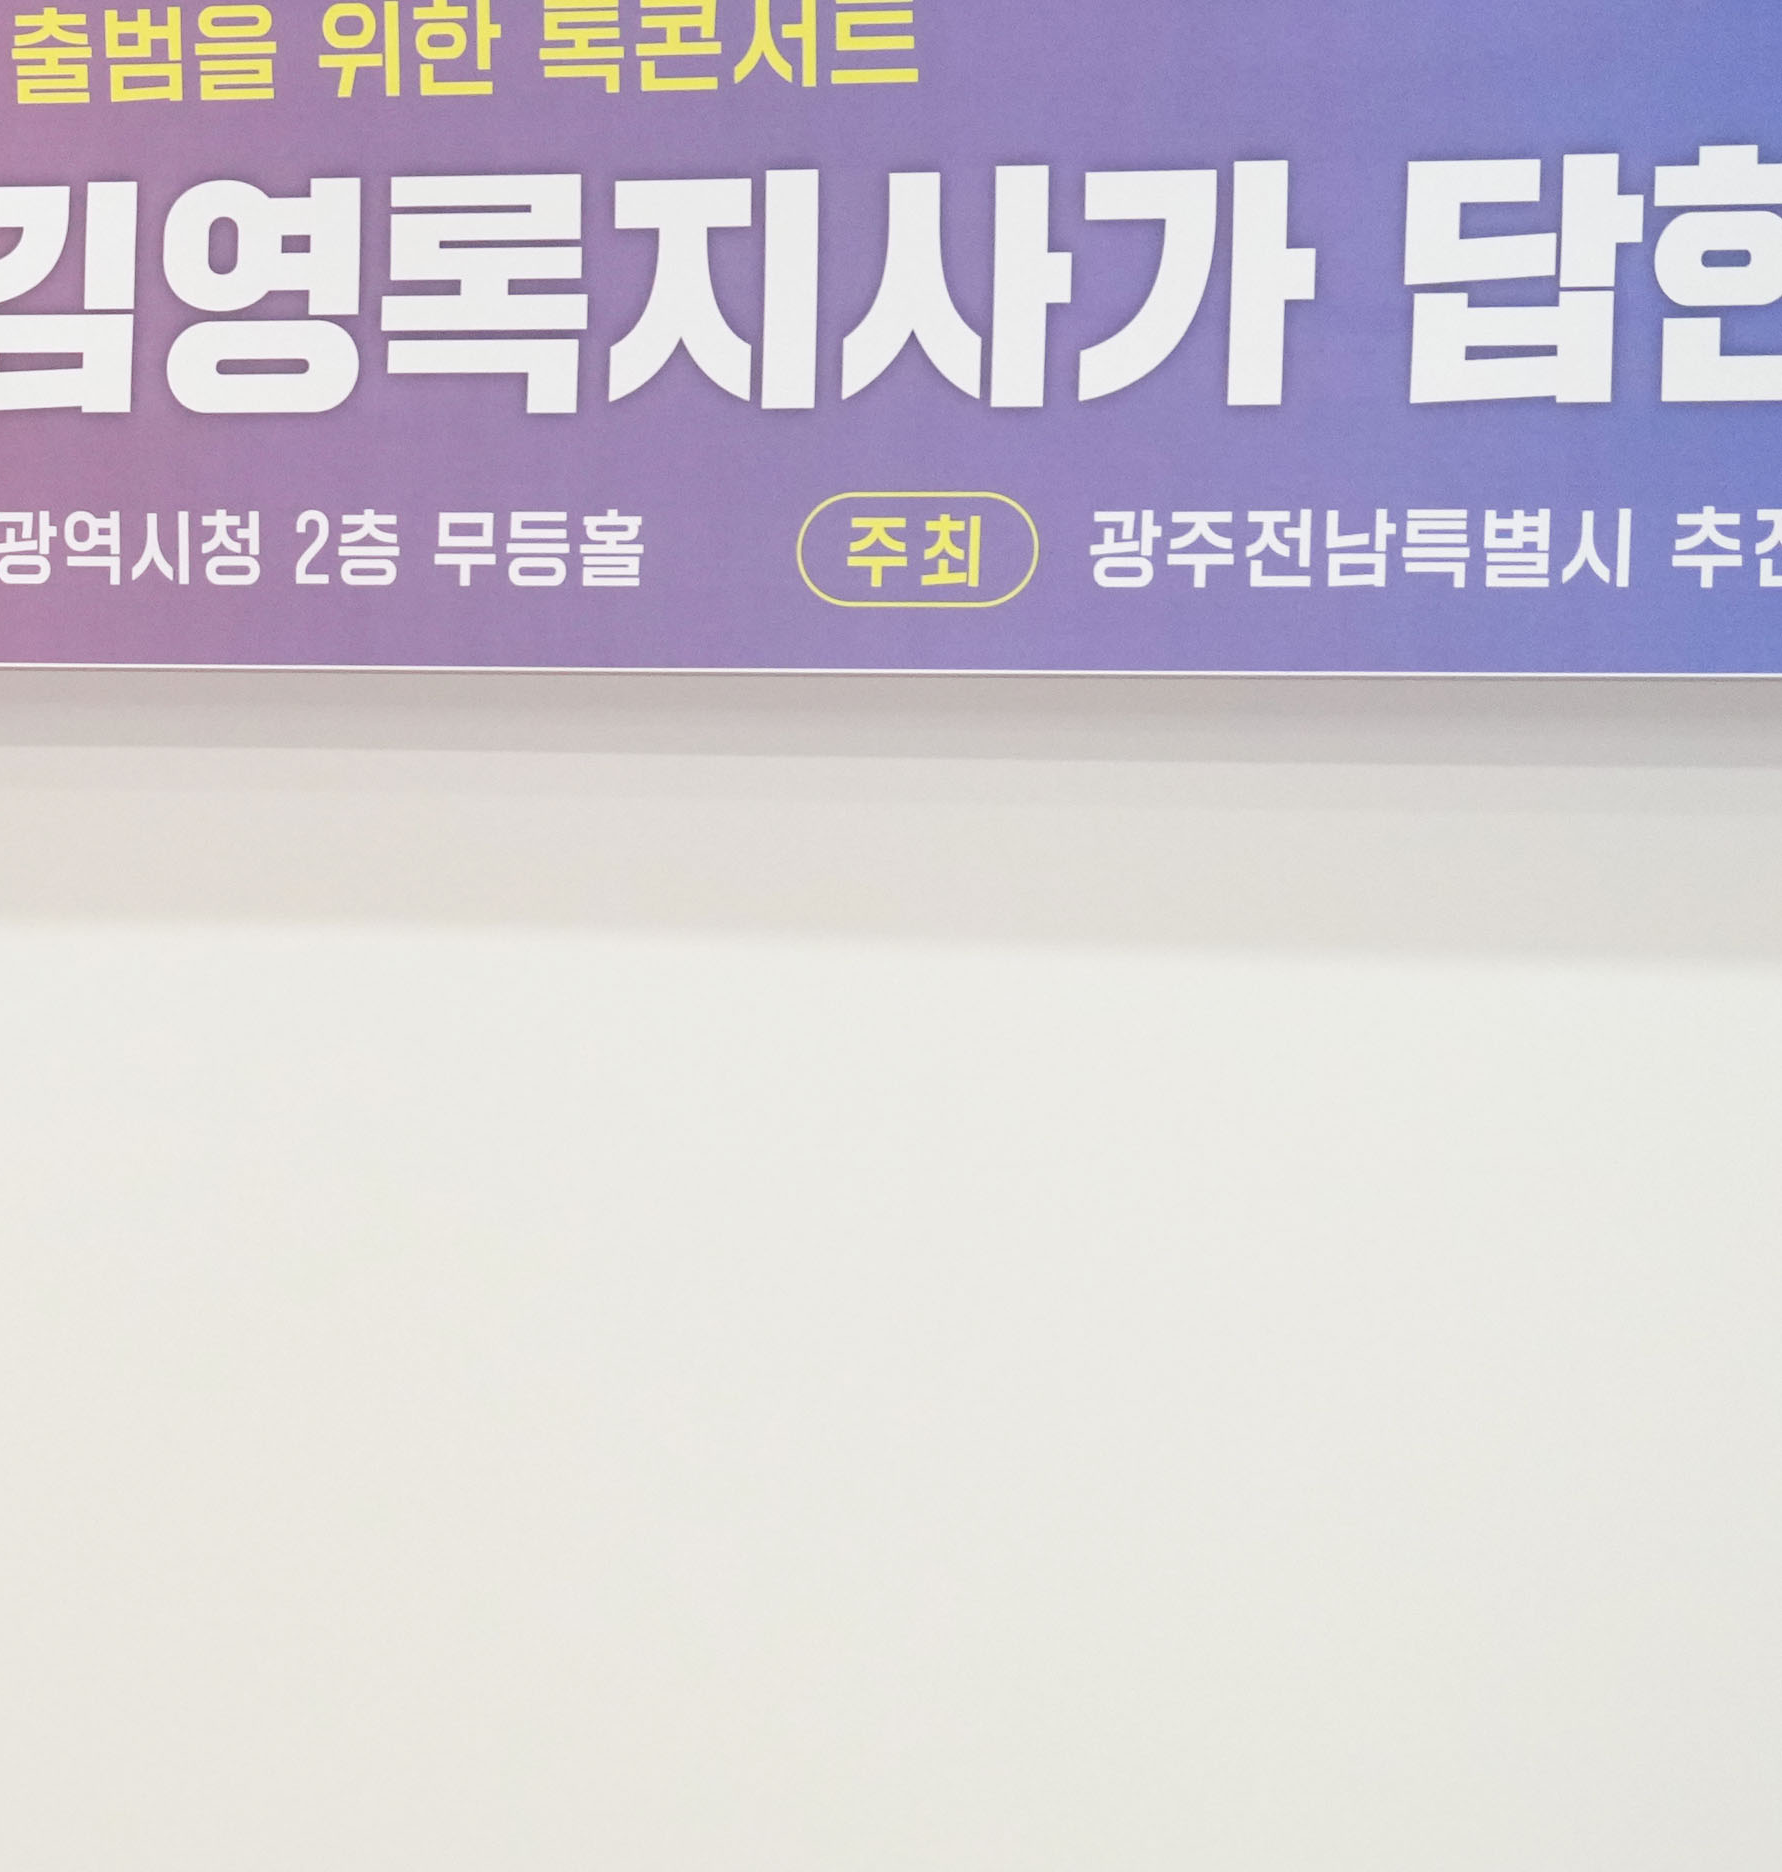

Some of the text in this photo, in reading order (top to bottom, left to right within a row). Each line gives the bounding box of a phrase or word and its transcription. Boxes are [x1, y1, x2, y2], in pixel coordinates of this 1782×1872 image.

[11, 5, 279, 104] 출범을
[317, 0, 503, 98] 위한
[538, 0, 920, 93] 톡콘서트
[294, 508, 401, 587] 2층
[433, 507, 645, 588] 무등홀
[847, 514, 981, 587] 주최
[1088, 506, 1633, 591] 광주전남특별시
